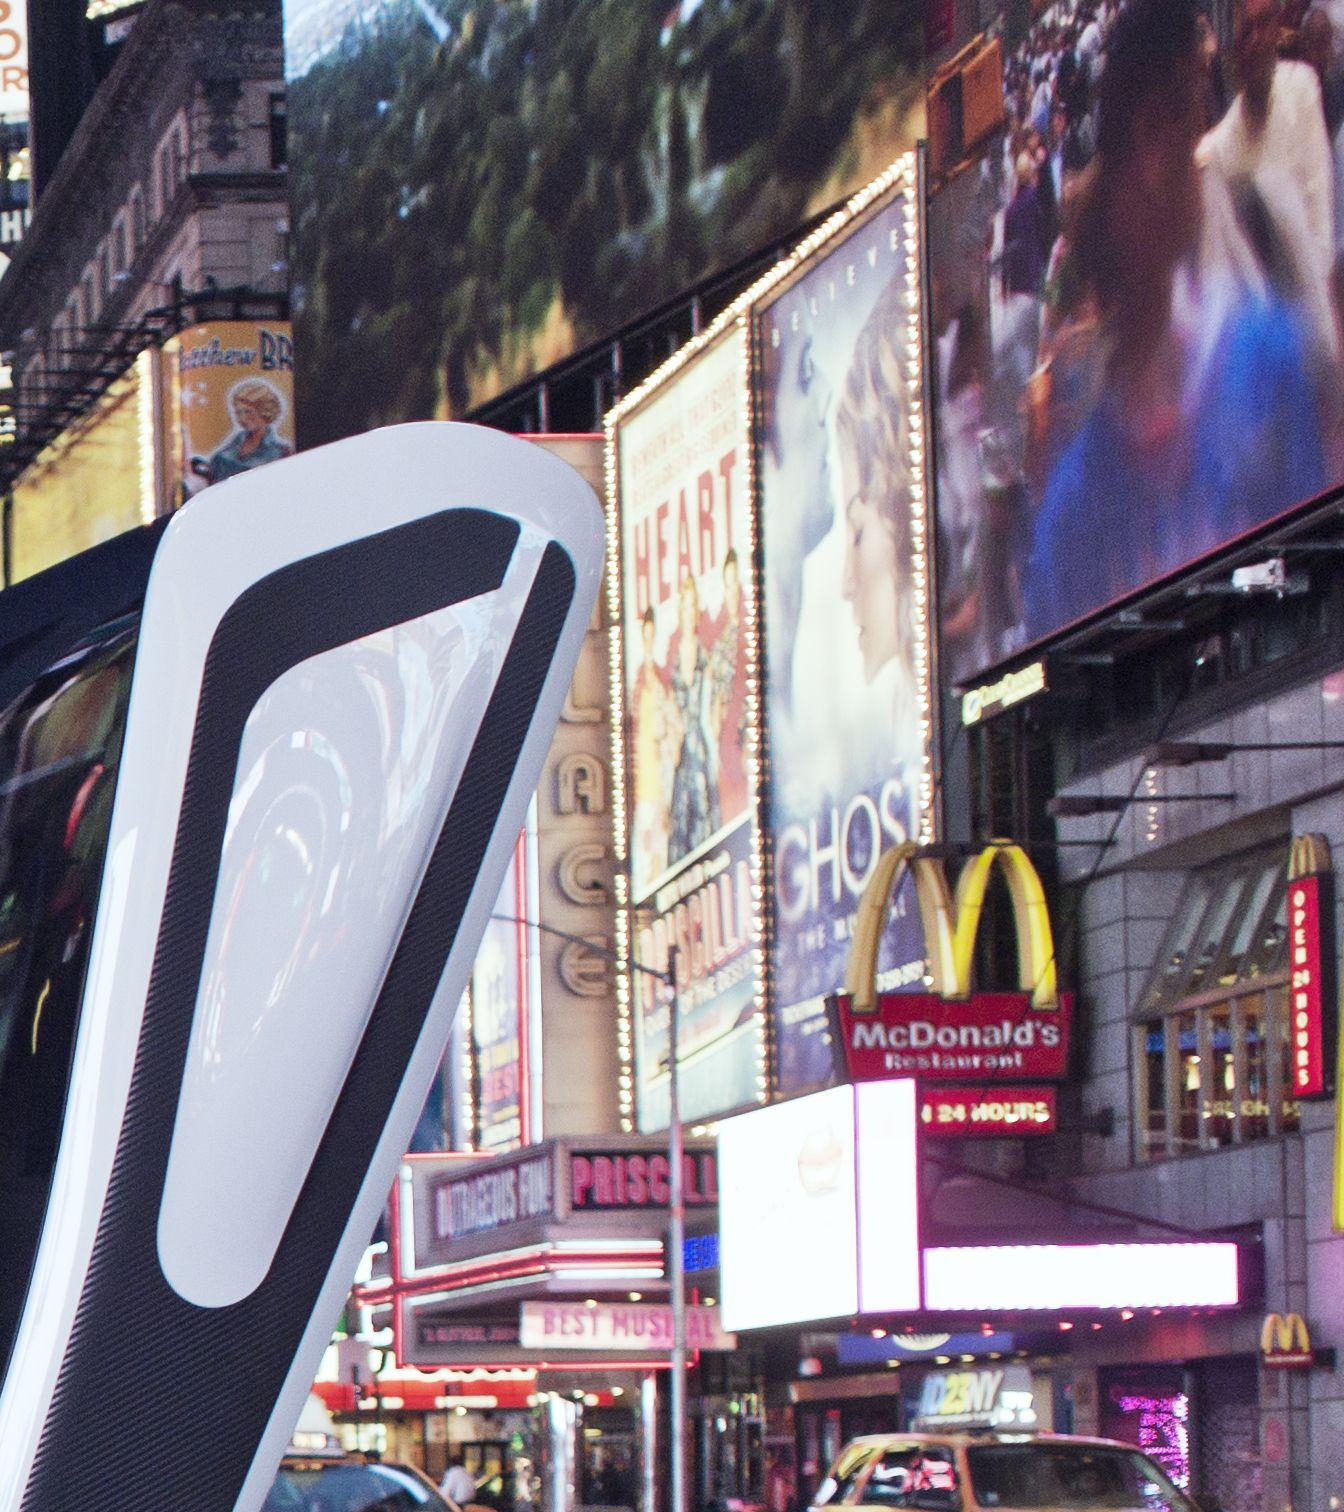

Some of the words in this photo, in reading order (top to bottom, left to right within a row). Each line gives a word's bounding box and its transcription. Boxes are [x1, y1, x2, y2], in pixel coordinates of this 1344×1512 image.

[633, 448, 737, 622] HEART
[1293, 889, 1308, 965] OPEN
[851, 1019, 1061, 1050] McDonald's
[1295, 992, 1310, 1087] HOURS
[884, 1051, 1024, 1070] Restaurant
[937, 1103, 967, 1122] 24
[971, 1102, 1050, 1123] HOURS
[572, 1154, 719, 1206] PRISCLL
[542, 1307, 600, 1338] BEST
[612, 1307, 716, 1340] MUSIAL
